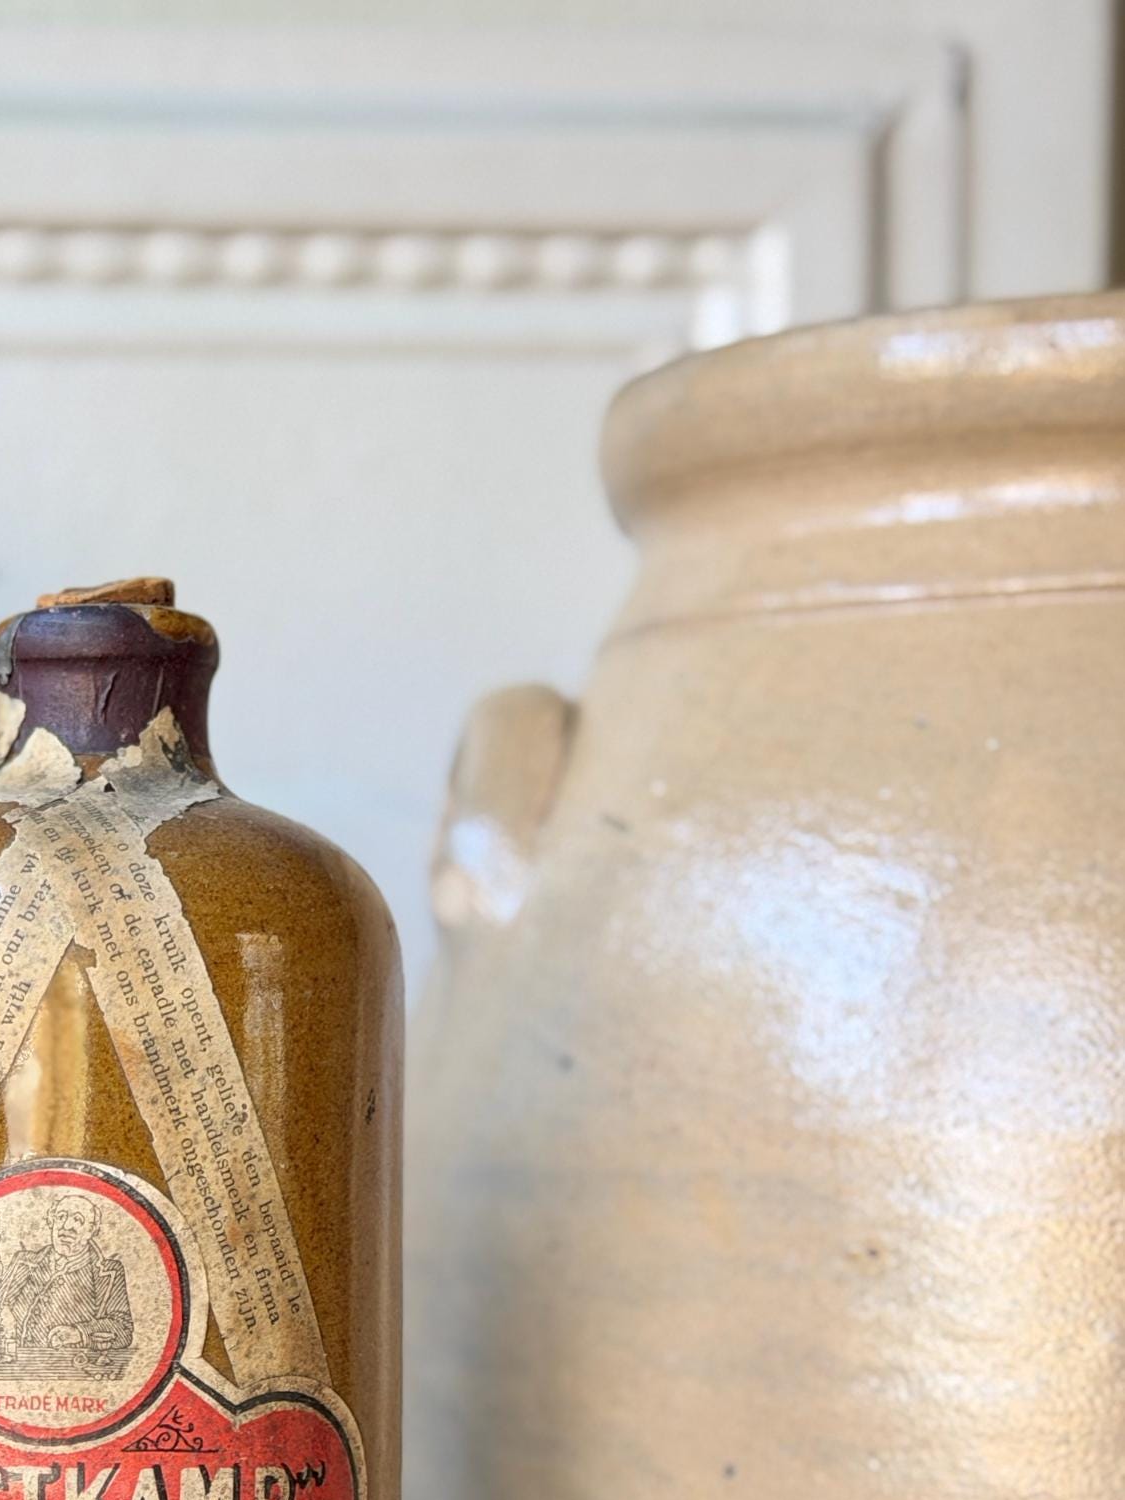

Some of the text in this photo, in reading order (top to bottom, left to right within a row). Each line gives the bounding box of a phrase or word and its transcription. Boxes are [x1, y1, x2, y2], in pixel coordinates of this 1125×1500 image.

[1, 980, 31, 1026] with
[2, 929, 25, 966] our
[71, 868, 102, 917] kurk
[96, 920, 123, 962] met
[116, 970, 139, 1007] ons
[133, 1012, 189, 1131] brandmerk
[180, 1137, 240, 1281] ongeschonden
[235, 1288, 258, 1335] zijn.
[124, 914, 142, 938] de
[172, 1038, 198, 1079] met
[191, 1087, 251, 1224] handelsmerk
[244, 1233, 259, 1259] en
[255, 1266, 281, 1326] firma
[154, 913, 188, 973] kruik
[180, 987, 214, 1053] opent,
[241, 1150, 262, 1188] den
[56, 1396, 109, 1413] MARK
